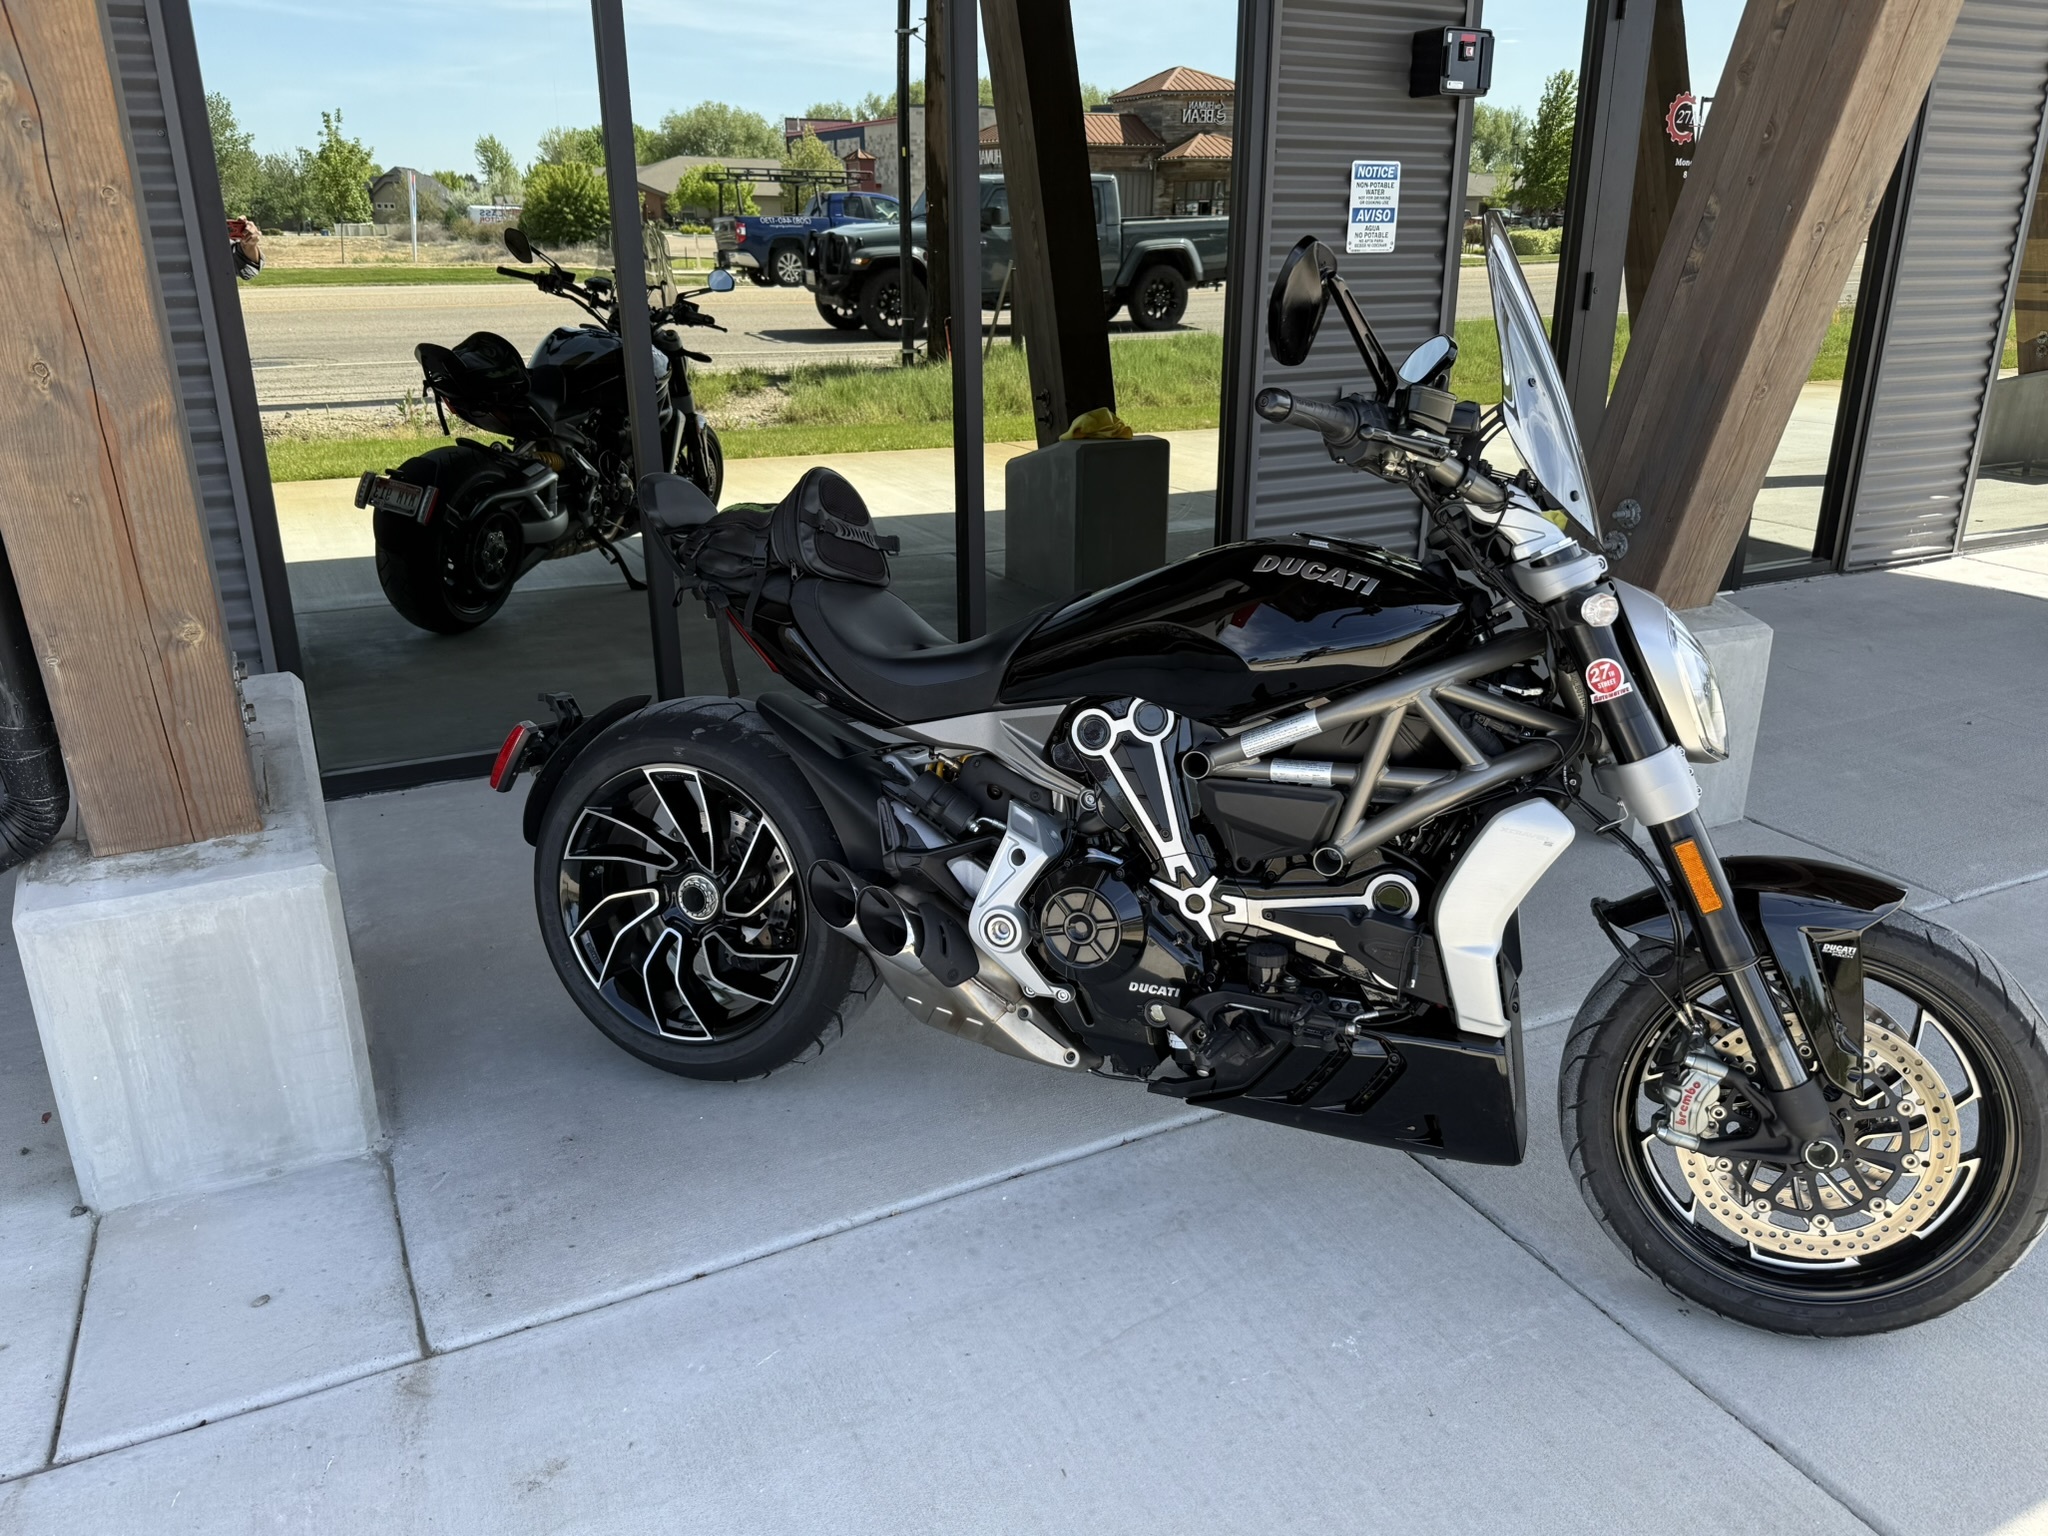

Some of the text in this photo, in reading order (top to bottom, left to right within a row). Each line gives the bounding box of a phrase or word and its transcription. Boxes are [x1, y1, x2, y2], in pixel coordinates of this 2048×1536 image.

[1357, 166, 1395, 178] NOTICE
[1356, 181, 1395, 189] NON-POTABLE
[1356, 209, 1391, 222] AVISO
[1252, 554, 1381, 596] DUCATI
[1590, 662, 1611, 684] 27
[1597, 677, 1617, 690] STREET
[1822, 943, 1857, 954] DUCATI
[1128, 981, 1181, 998] DUCATI
[1675, 1081, 1702, 1126] brembo
